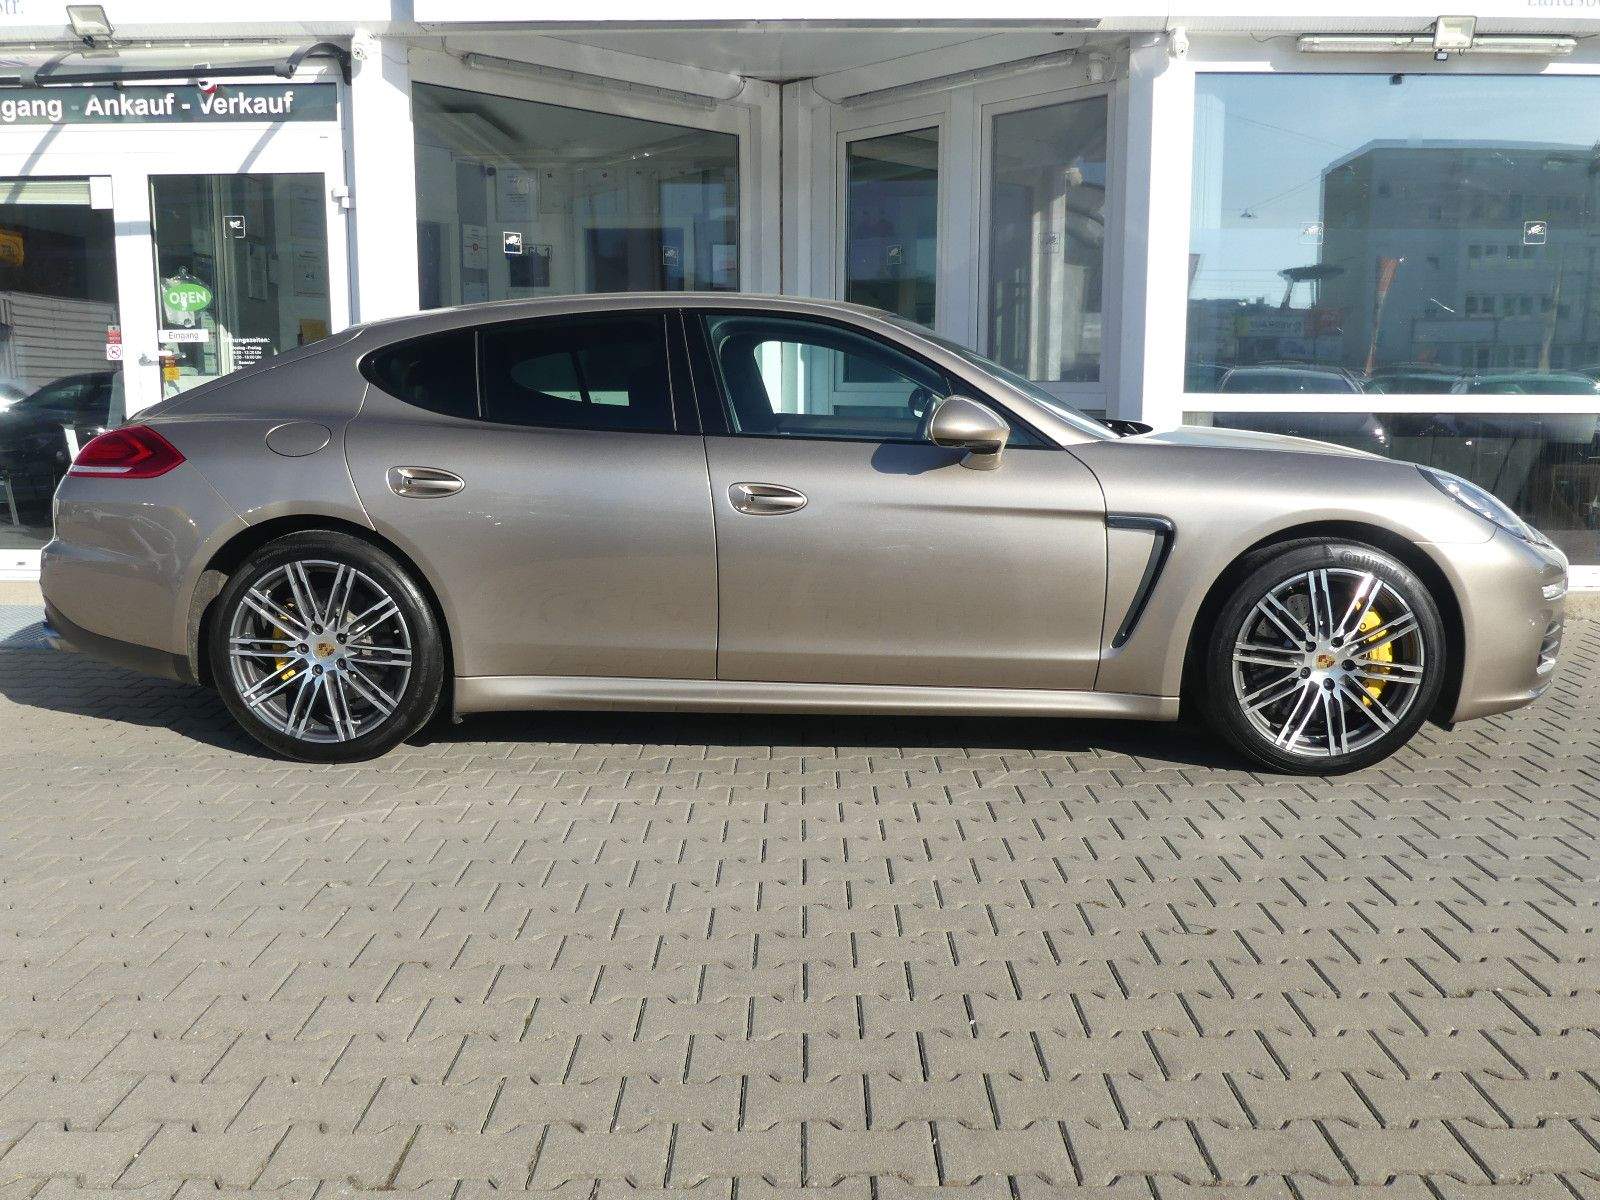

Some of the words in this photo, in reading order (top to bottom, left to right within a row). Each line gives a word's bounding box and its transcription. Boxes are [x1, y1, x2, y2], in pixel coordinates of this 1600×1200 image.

[1, 99, 63, 122] gang
[84, 92, 175, 116] Ankauf
[197, 91, 294, 116] Verkauf
[169, 291, 207, 305] OPEN
[168, 331, 199, 341] Eingang
